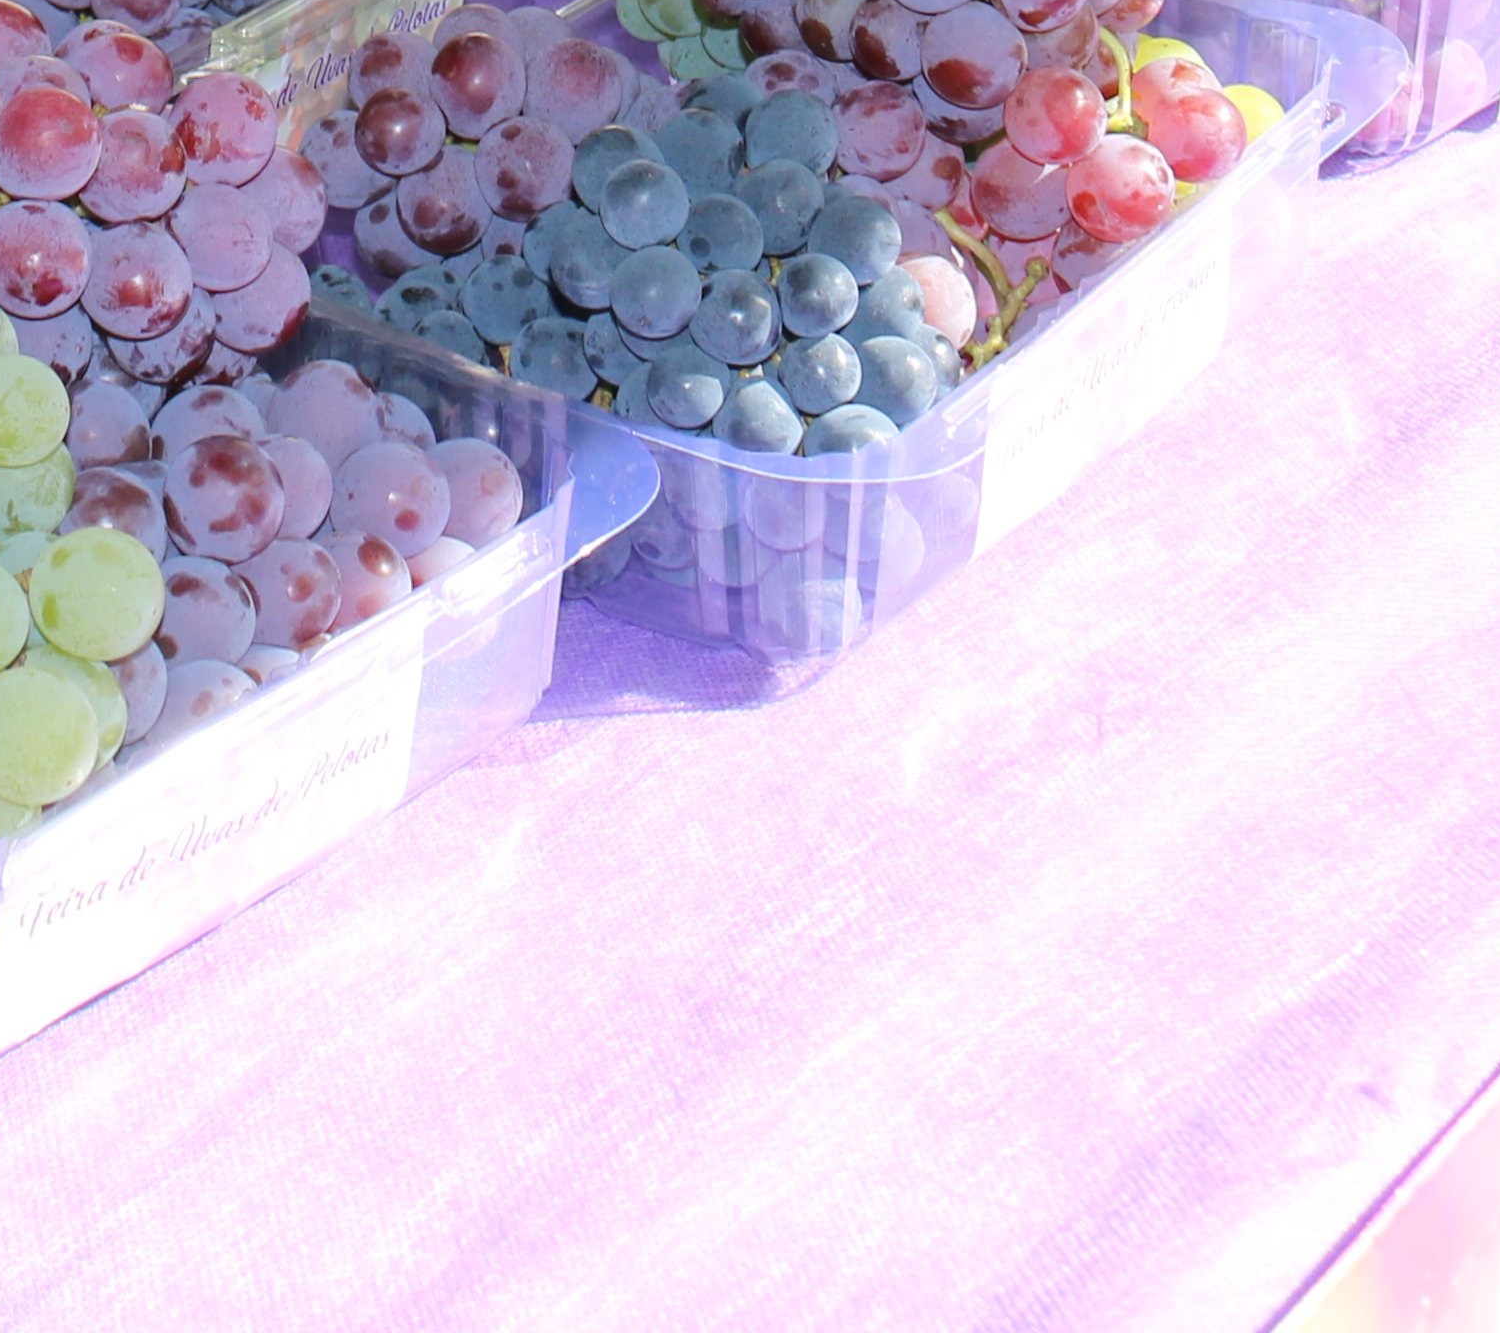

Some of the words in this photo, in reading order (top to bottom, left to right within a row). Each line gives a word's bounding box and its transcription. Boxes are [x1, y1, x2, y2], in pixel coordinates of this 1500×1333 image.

[276, 73, 298, 109] de
[20, 877, 109, 941] Feira
[118, 844, 156, 893] de
[168, 813, 247, 867] Uvas
[252, 777, 289, 828] de
[299, 726, 393, 801] Pelotas
